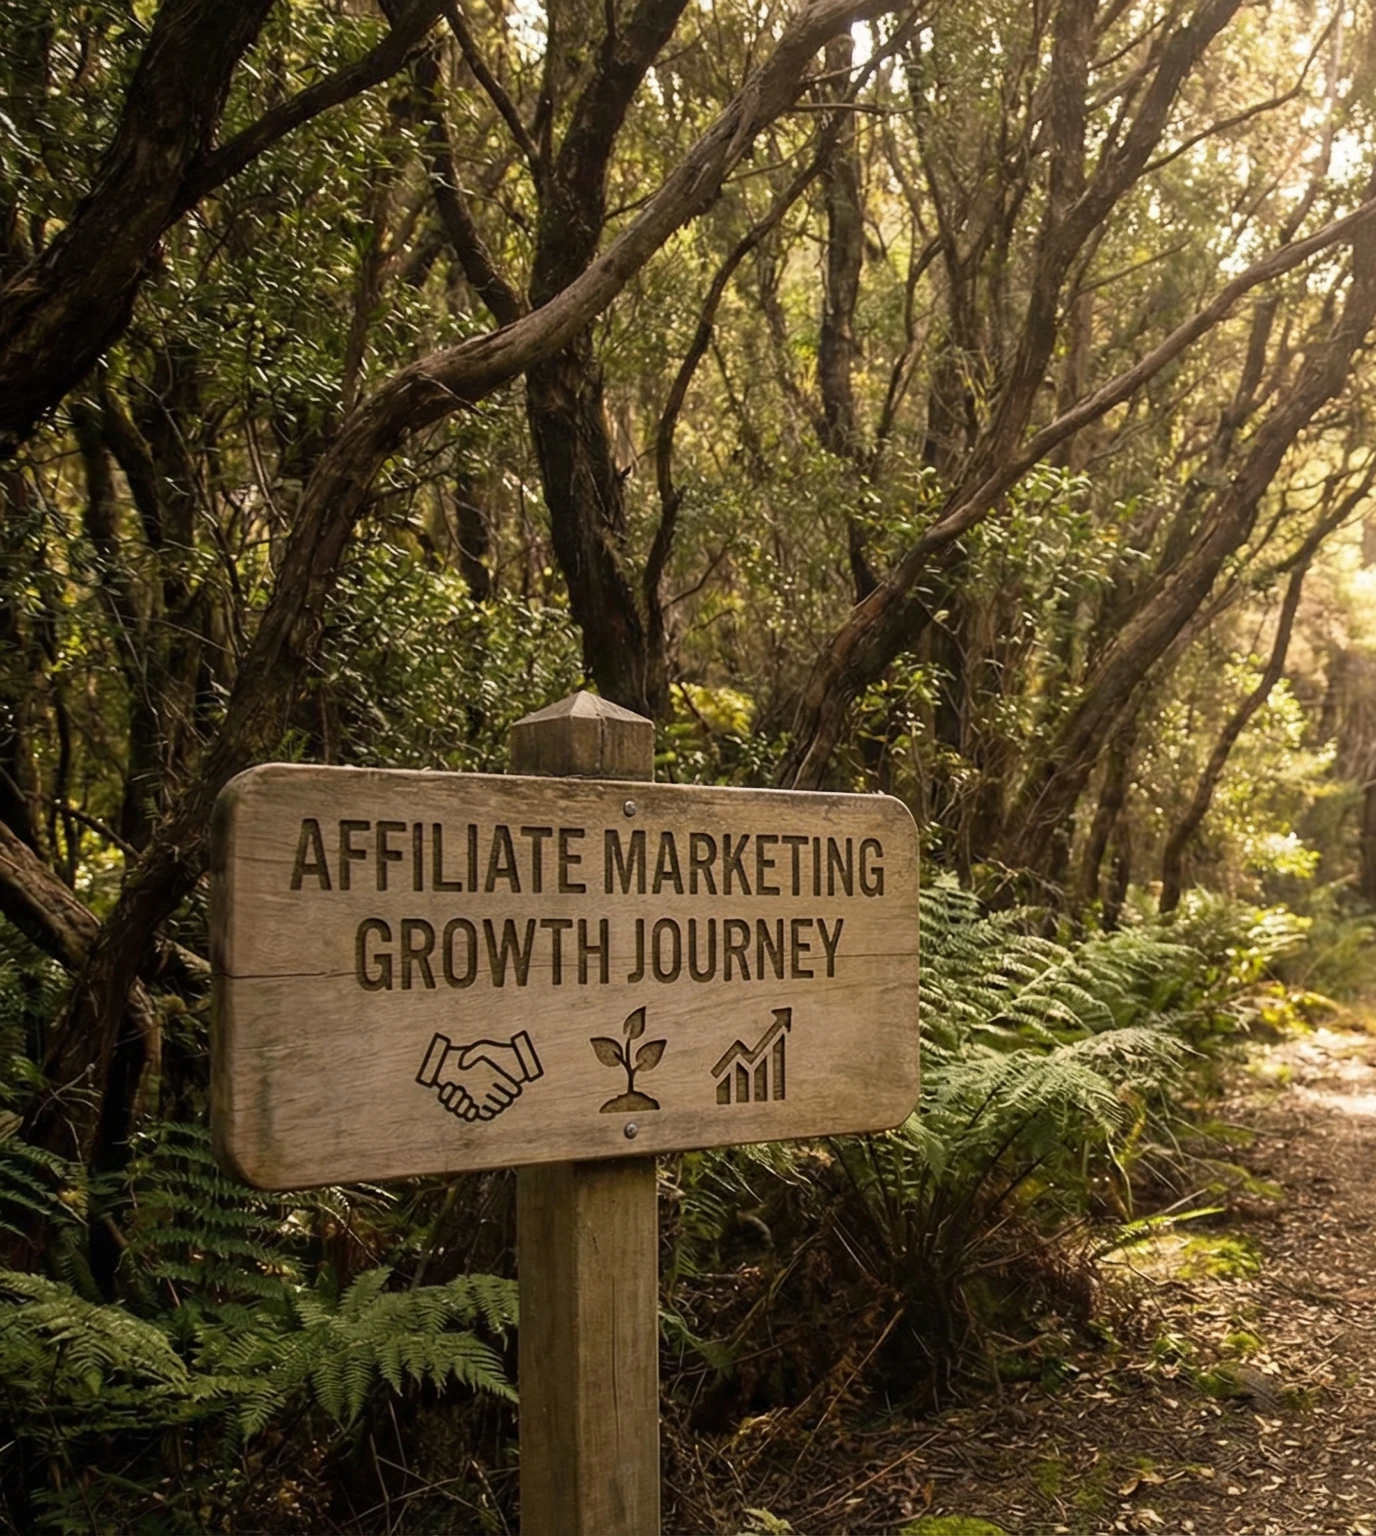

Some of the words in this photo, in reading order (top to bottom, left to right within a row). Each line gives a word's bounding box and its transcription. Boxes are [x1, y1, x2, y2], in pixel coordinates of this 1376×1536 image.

[290, 818, 587, 894] AFFILIATE
[604, 829, 885, 897] MARKETING
[355, 917, 610, 991] GROWTH
[627, 917, 845, 984] JOURNEY
